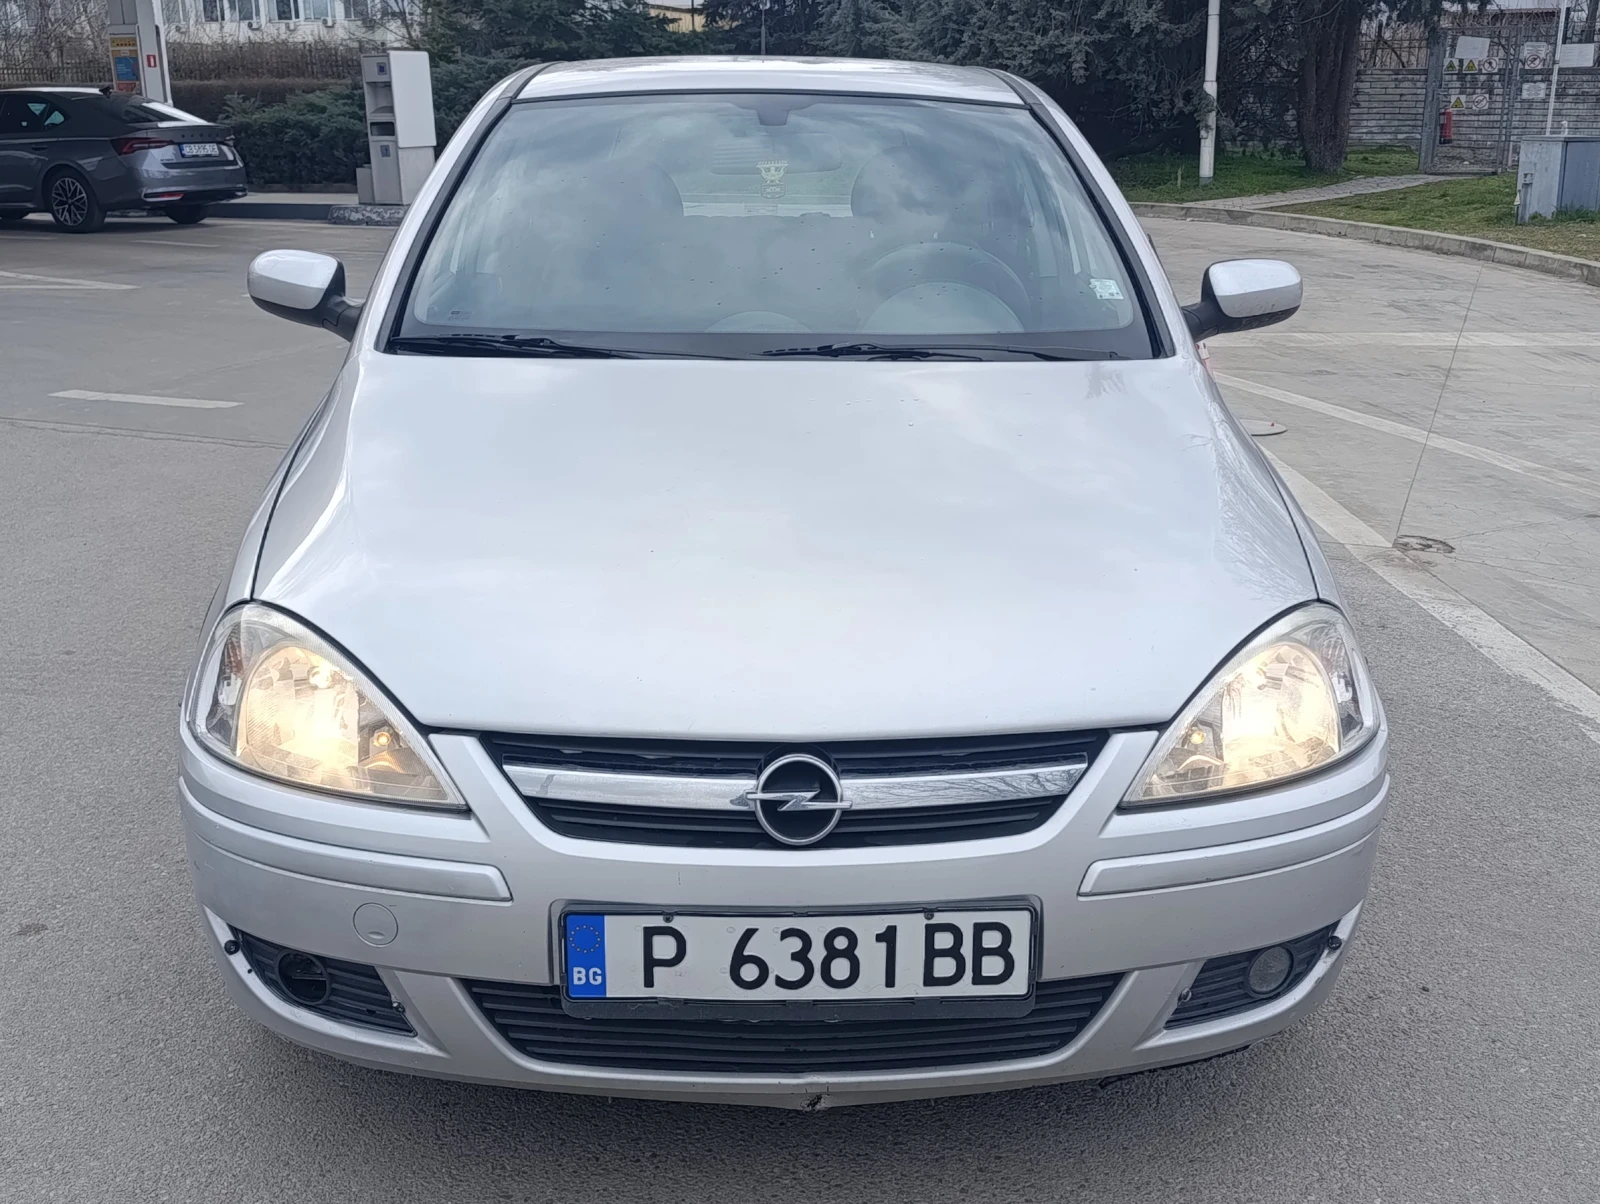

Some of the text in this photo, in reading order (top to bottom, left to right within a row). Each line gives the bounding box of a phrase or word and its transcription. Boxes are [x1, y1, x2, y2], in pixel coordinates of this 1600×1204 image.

[573, 967, 602, 985] BG
[642, 921, 1015, 991] P 6381 BB
